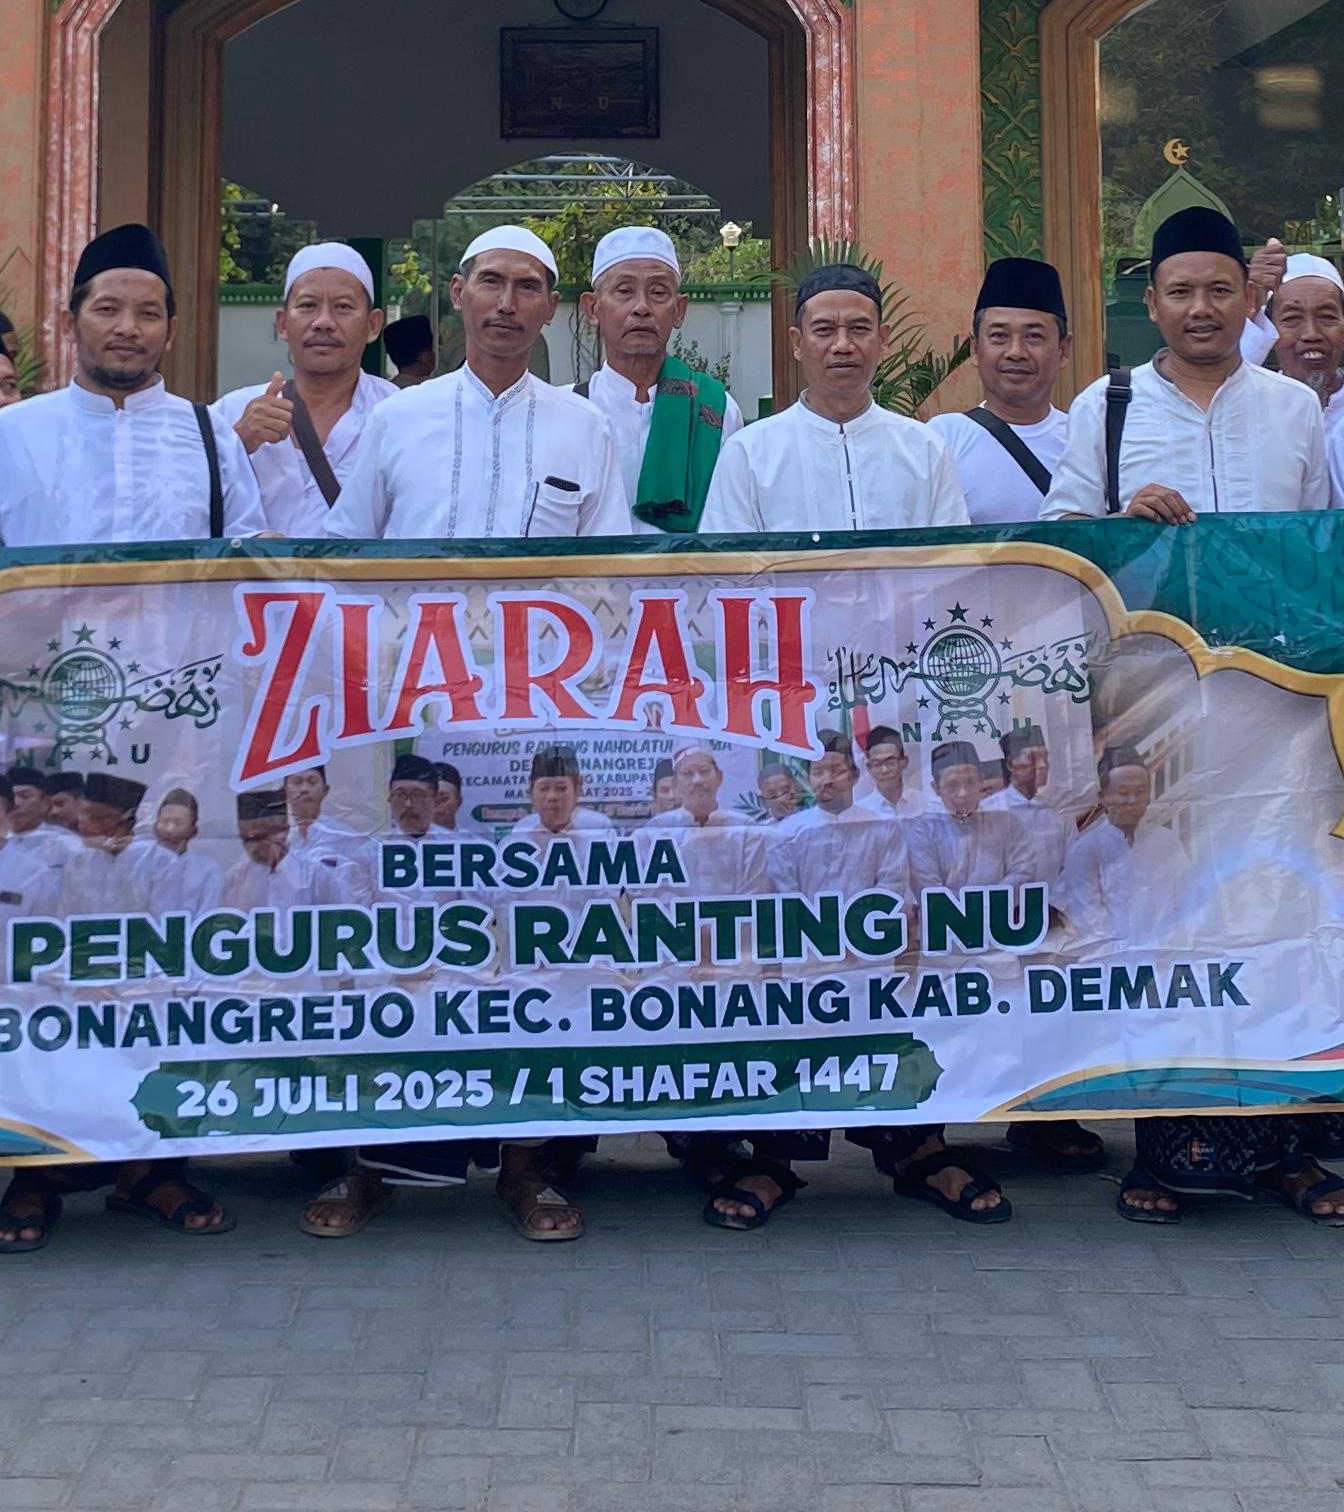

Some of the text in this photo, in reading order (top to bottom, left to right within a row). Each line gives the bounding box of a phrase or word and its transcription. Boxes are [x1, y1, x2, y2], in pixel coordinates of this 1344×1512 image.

[239, 591, 817, 783] ZIARAH
[130, 743, 151, 764] U
[382, 839, 687, 888] BERSAMA
[12, 887, 1045, 982] PENGURUS RANTING NU
[433, 987, 572, 1037] KEC.
[590, 979, 851, 1033] BONANG
[868, 971, 1012, 1021] KAB.
[1028, 961, 1251, 1015] DEMAK
[175, 1053, 900, 1118] 26 JULI 2025 / 1 SHAFAR 1447
